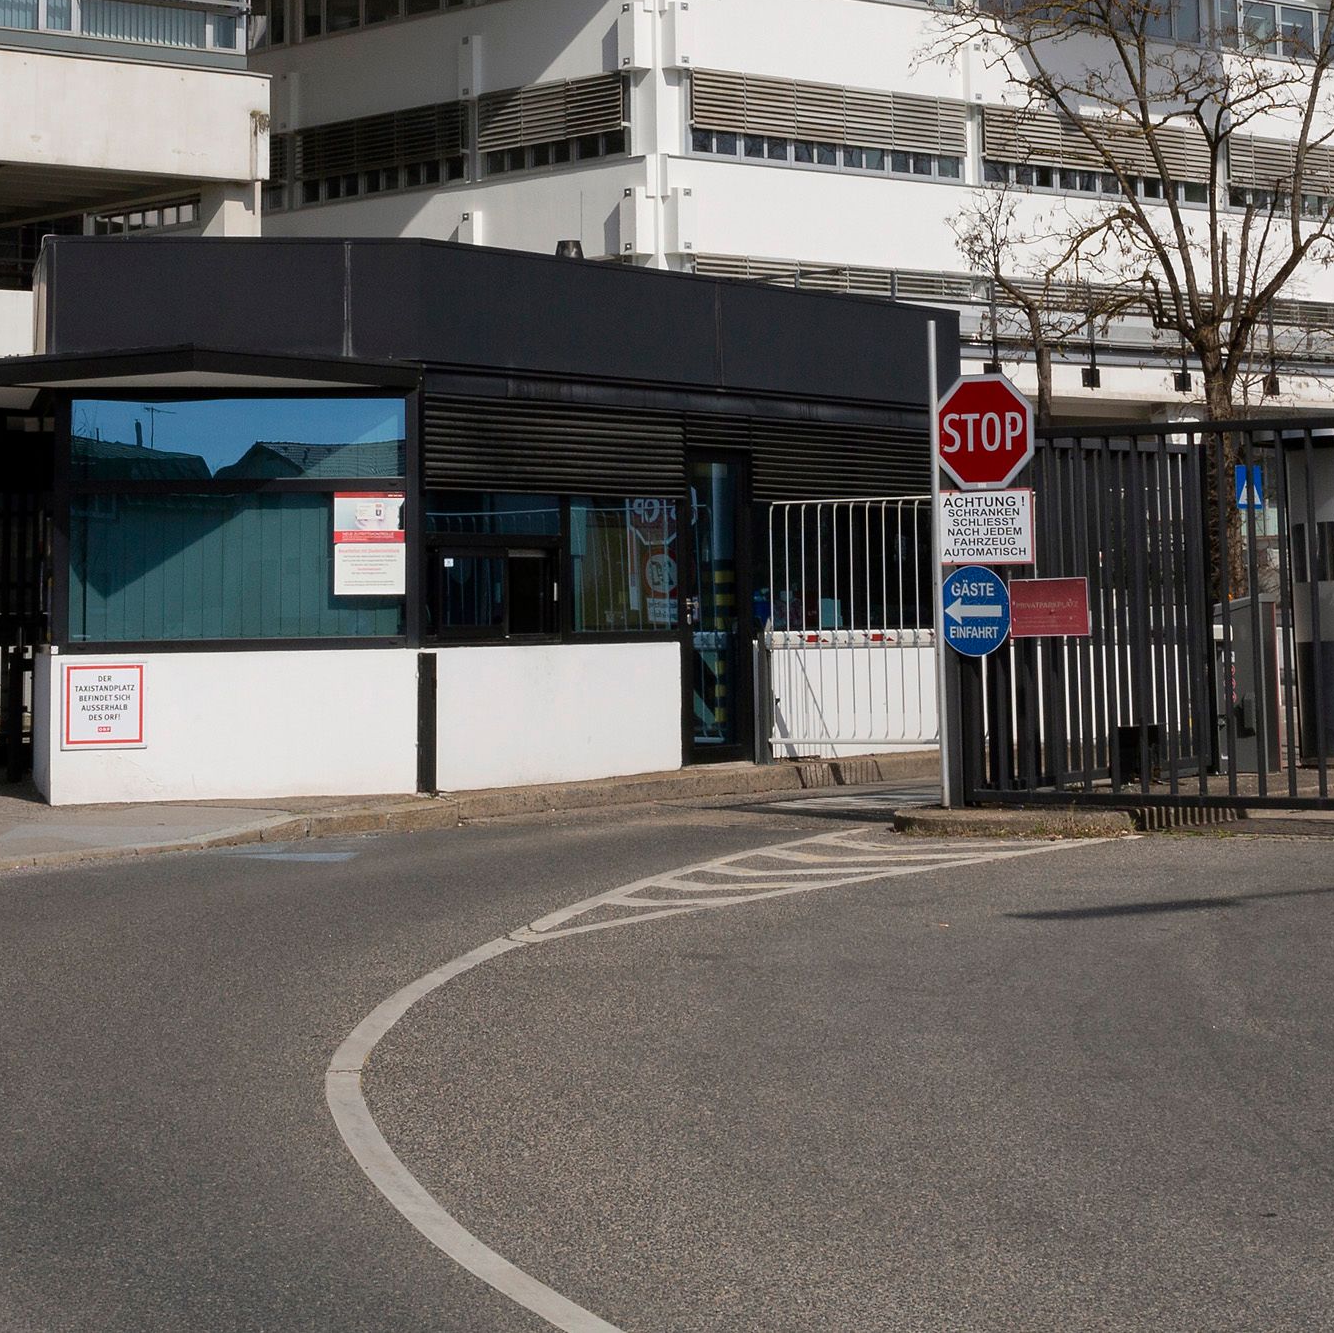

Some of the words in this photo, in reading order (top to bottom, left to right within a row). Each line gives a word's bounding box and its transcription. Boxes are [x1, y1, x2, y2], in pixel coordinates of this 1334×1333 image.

[942, 411, 1023, 453] STOP
[943, 496, 1016, 508] ACHTUNG
[948, 507, 1020, 517] SCHRANKEN
[952, 517, 1016, 527] SCHLIESST
[947, 527, 980, 537] NACH
[983, 526, 1022, 536] JEDEM
[954, 537, 1016, 547] FAHRZEUG
[944, 547, 1027, 557] AUTOMATISCH
[951, 579, 995, 598] GÄSTE
[949, 626, 999, 639] EINFAHRT
[75, 684, 135, 692] TAXISTANDPLATZ
[104, 713, 121, 721] ORF!
